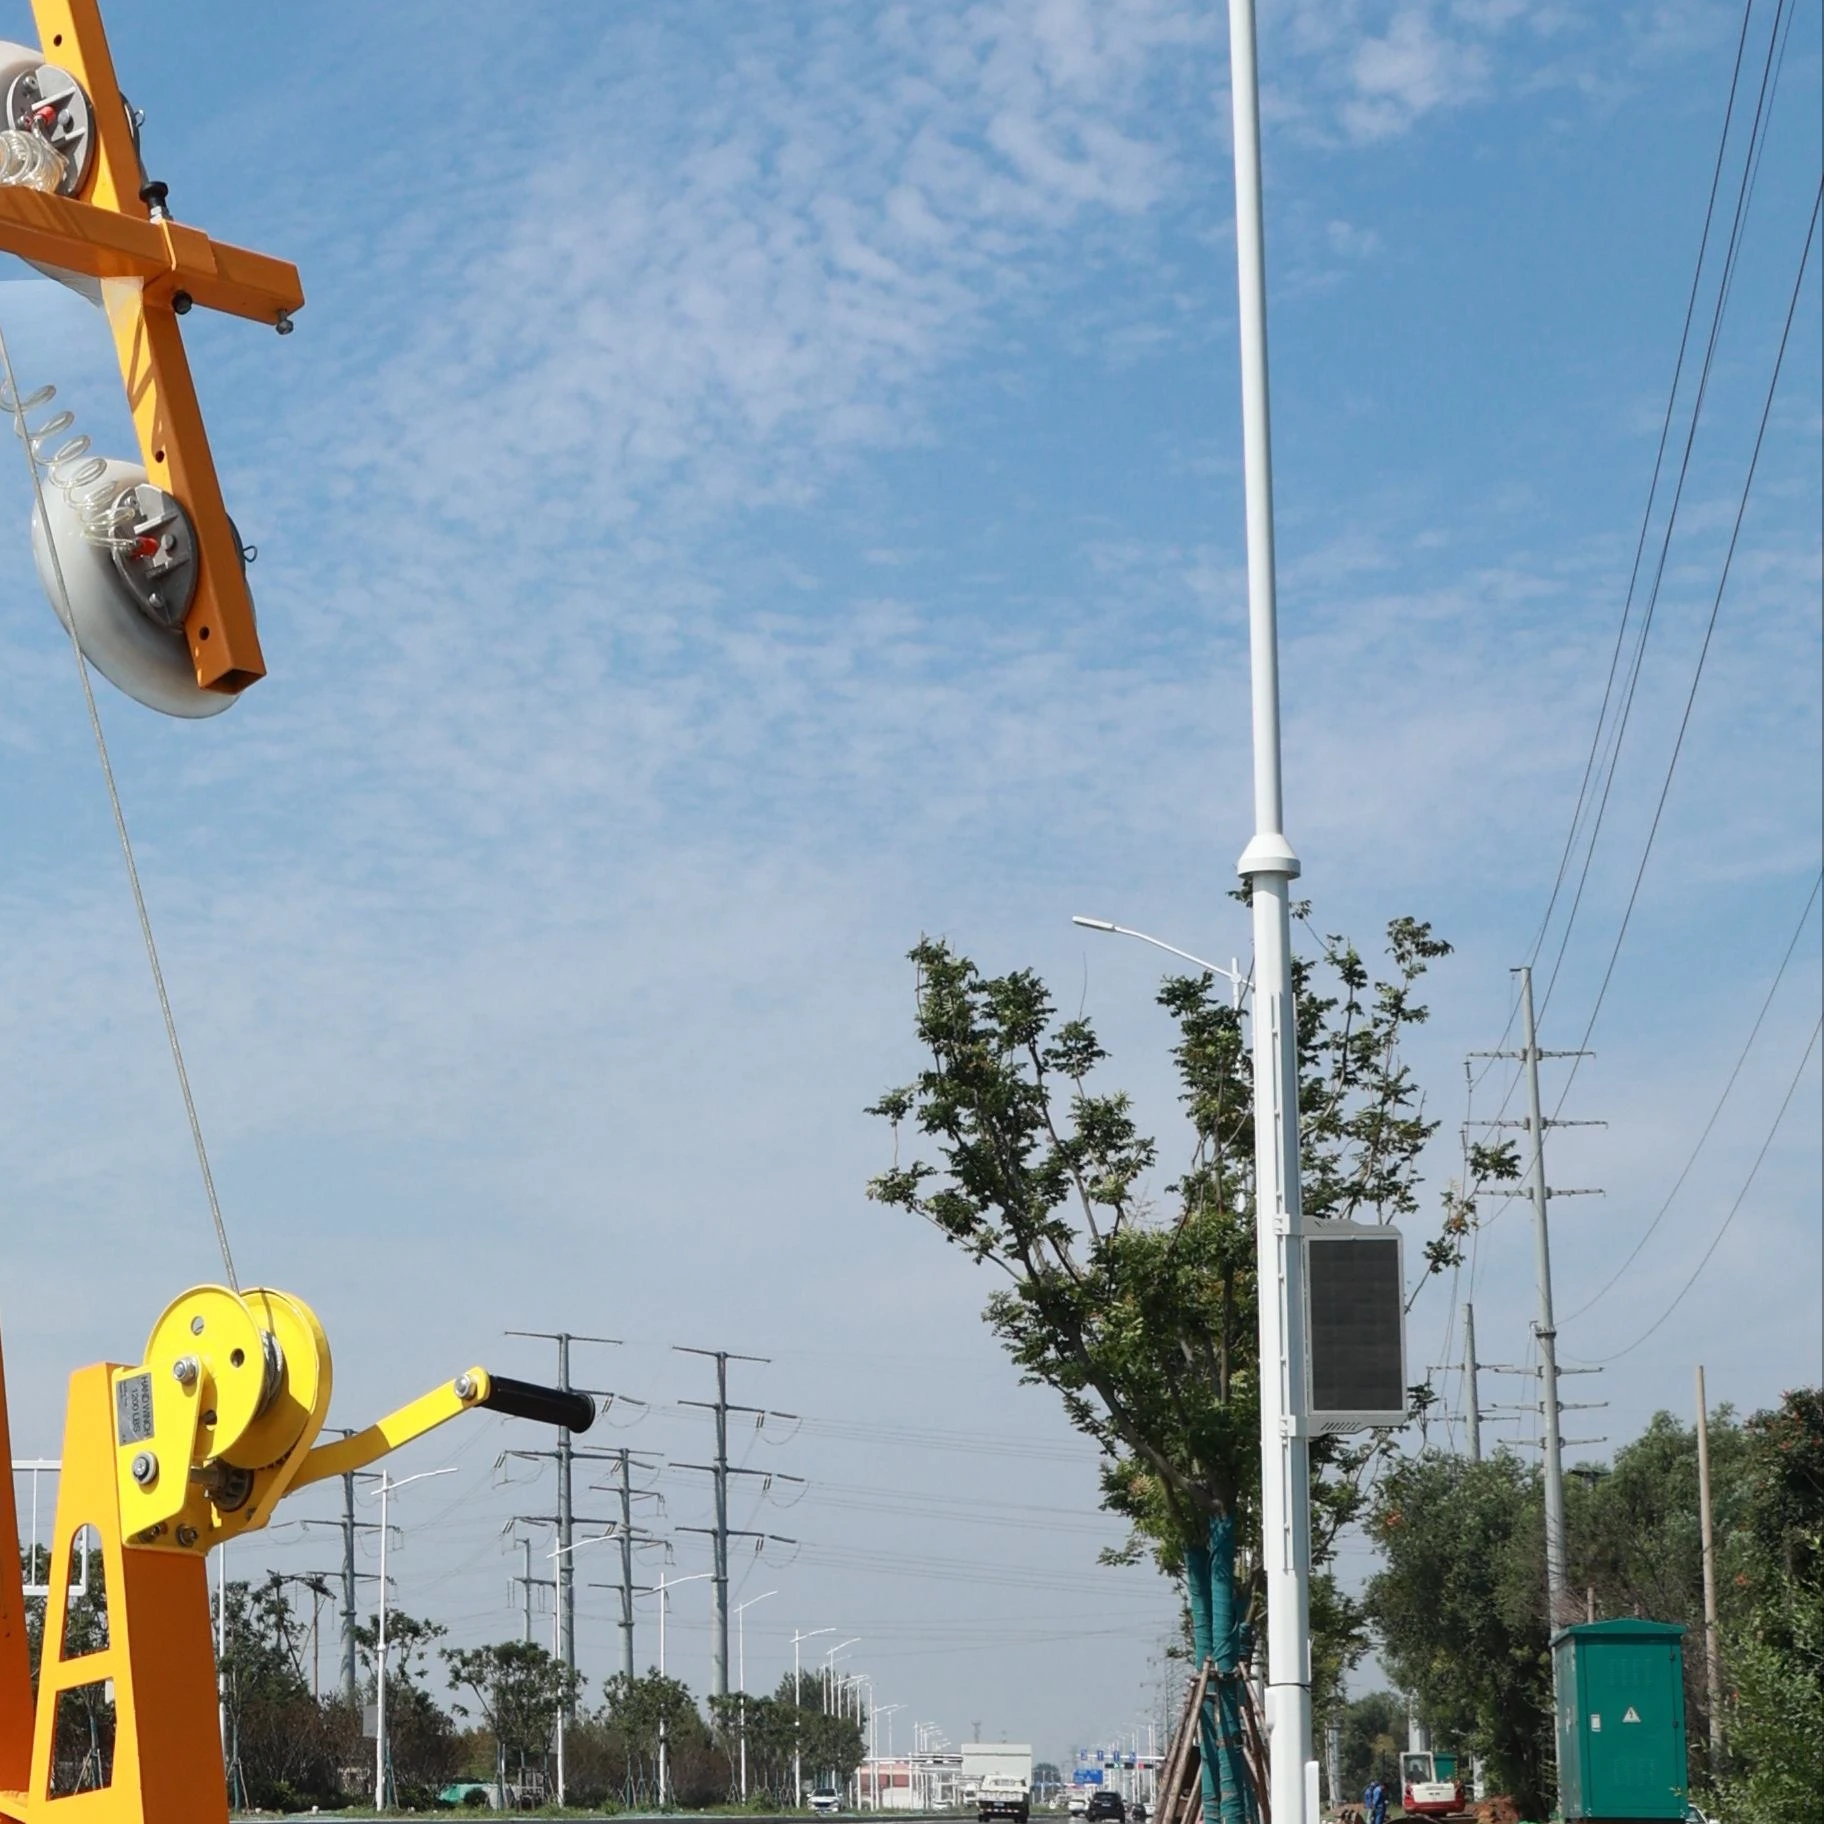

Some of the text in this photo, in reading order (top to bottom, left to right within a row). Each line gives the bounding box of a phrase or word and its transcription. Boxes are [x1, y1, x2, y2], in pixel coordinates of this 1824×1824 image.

[131, 1388, 141, 1433] 1200 LBS
[141, 1376, 151, 1436] HAND WINCH
